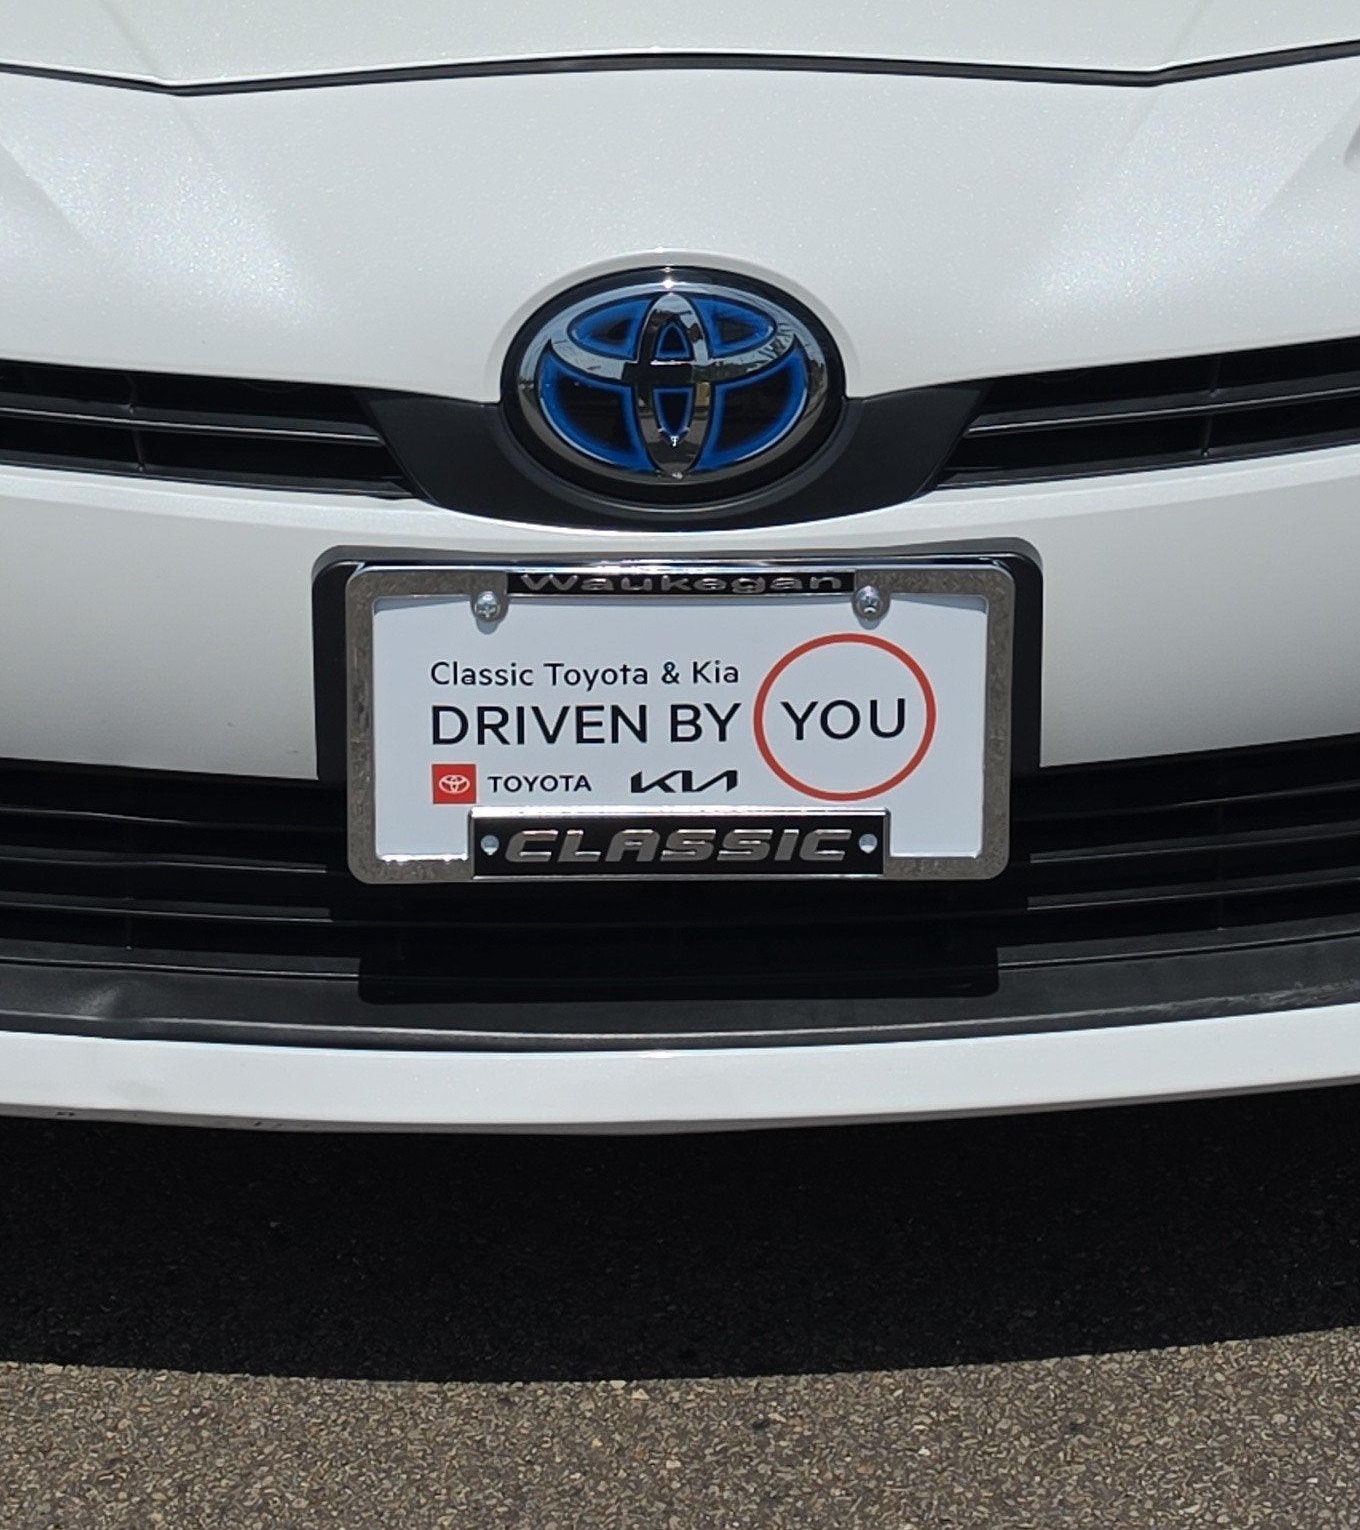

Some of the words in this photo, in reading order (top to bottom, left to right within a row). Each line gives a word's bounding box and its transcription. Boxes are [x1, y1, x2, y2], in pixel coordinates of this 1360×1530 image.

[520, 573, 843, 594] Waukegan
[431, 660, 534, 686] Classic
[543, 662, 648, 692] Toyota
[661, 661, 680, 685] &
[693, 660, 739, 684] Kia
[431, 704, 647, 746] DRIVEN
[669, 702, 742, 743] BY
[780, 698, 906, 741] YOU
[487, 774, 592, 793] TOYOTA
[505, 828, 852, 863] CLASSIC
